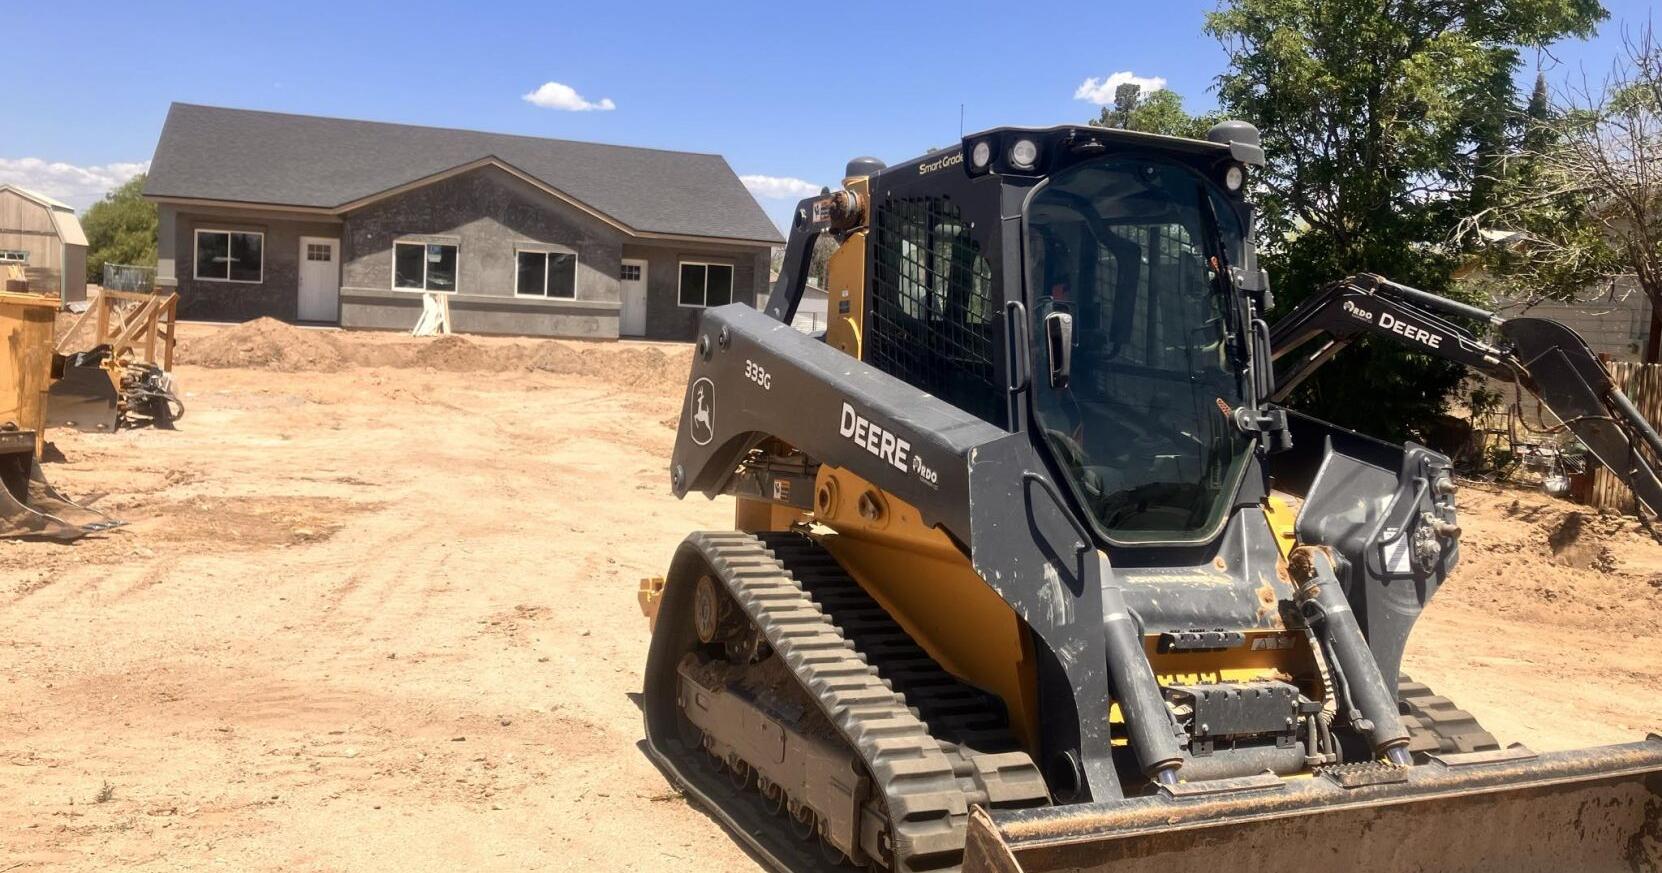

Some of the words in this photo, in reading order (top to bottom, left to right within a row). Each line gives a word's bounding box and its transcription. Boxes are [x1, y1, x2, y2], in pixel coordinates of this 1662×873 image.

[1352, 307, 1373, 320] RDO
[1378, 312, 1443, 349] DEERE
[744, 359, 771, 390] 333G
[840, 401, 911, 473] DEERE
[920, 464, 938, 483] RDO
